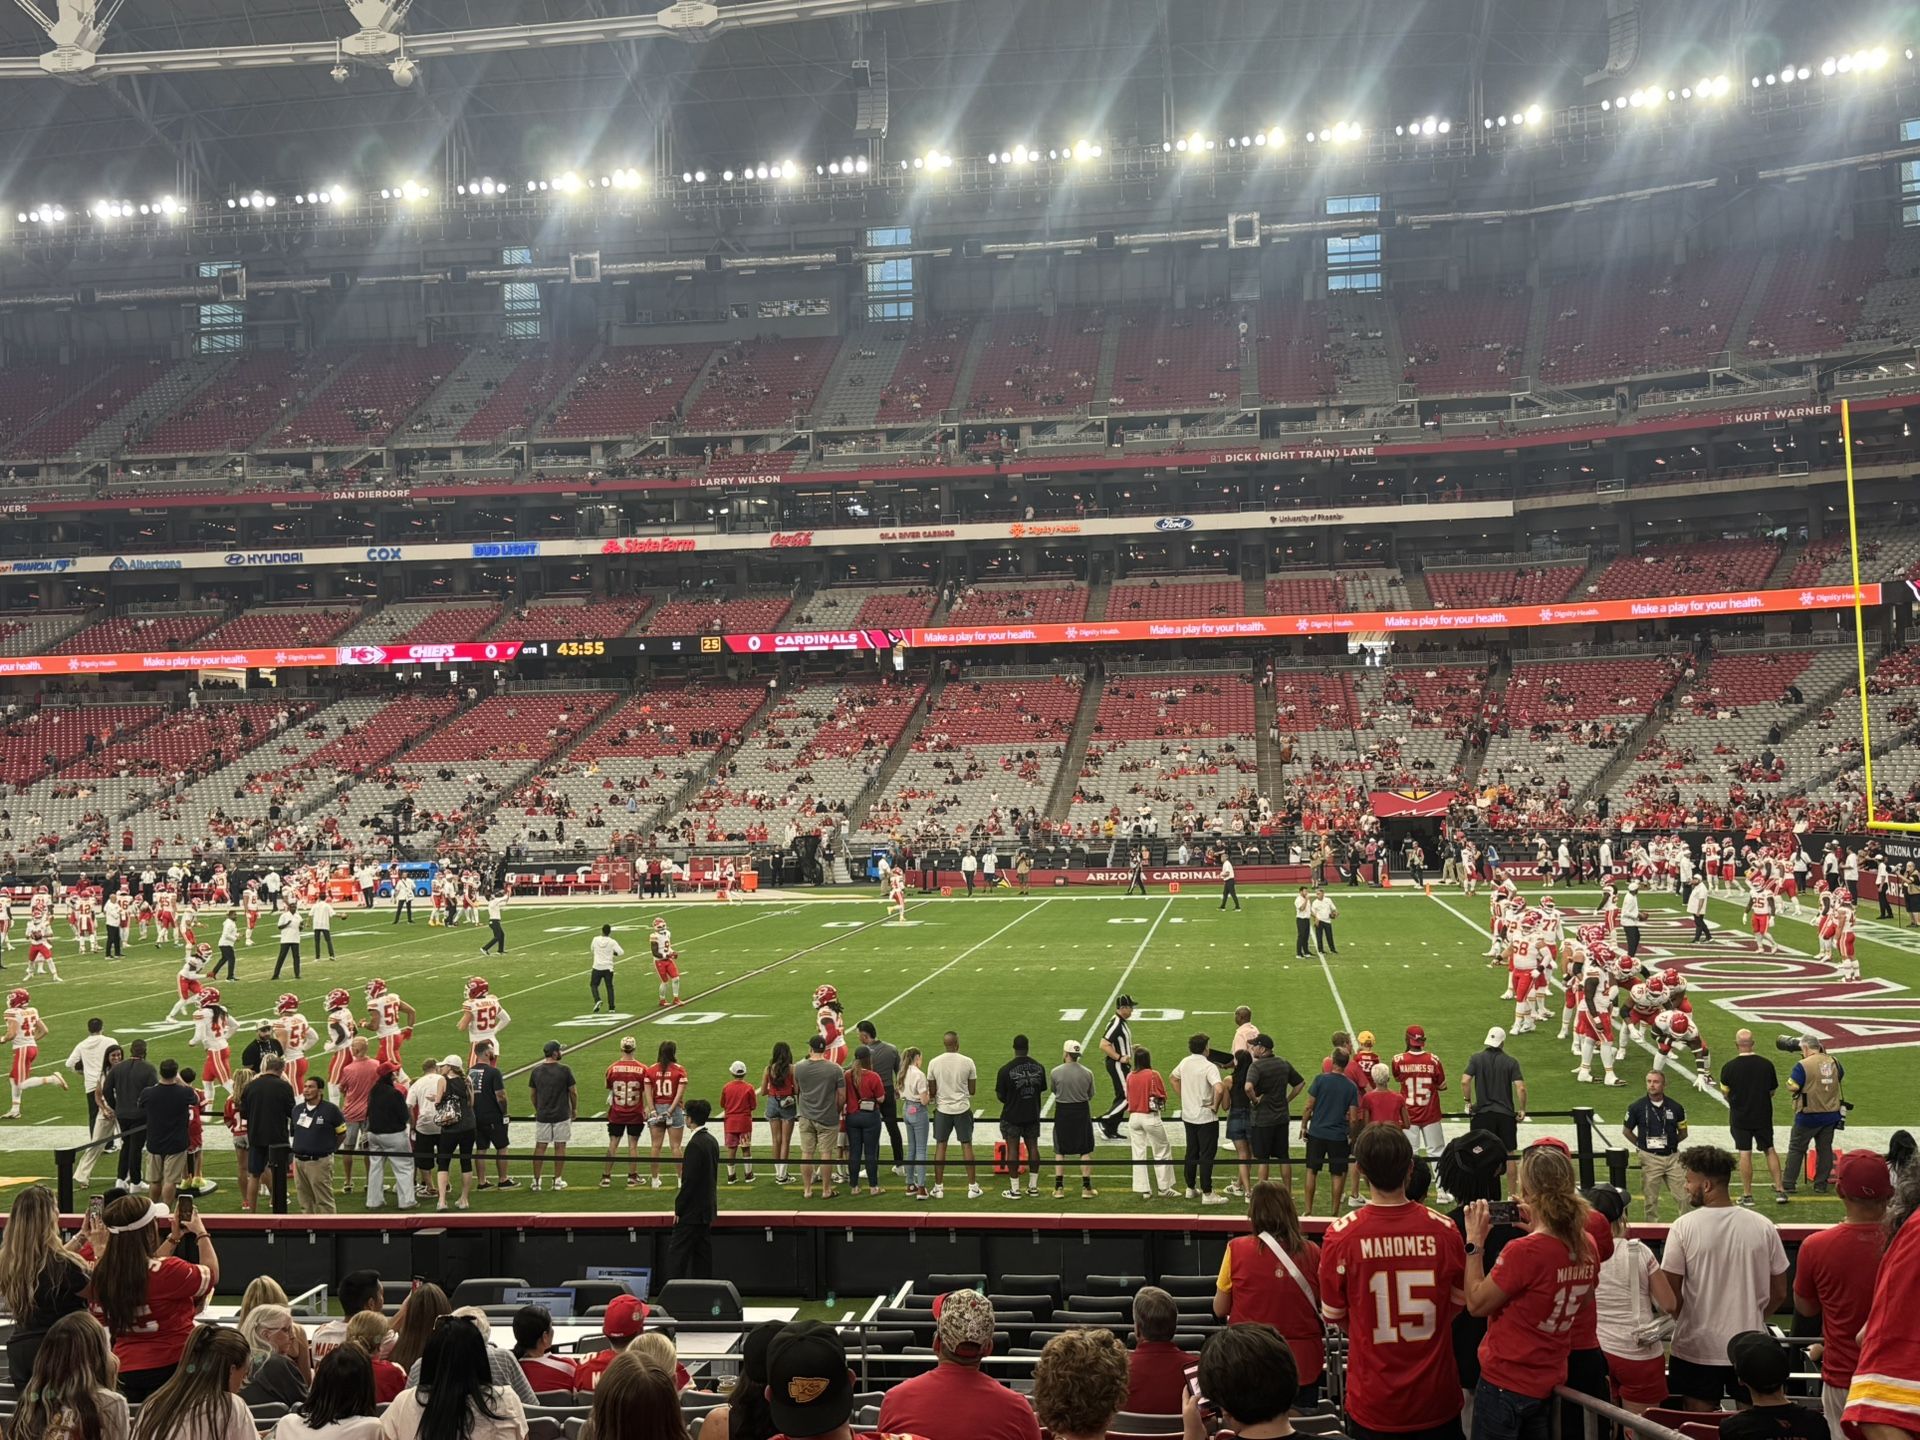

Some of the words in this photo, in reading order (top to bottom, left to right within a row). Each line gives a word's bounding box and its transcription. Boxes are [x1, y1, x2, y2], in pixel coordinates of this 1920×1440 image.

[1719, 415, 1732, 425] 13
[1735, 411, 1770, 423] KURT
[1775, 405, 1831, 418] WARNER
[1210, 455, 1222, 464] 81
[1225, 454, 1252, 462] DICK
[1255, 451, 1295, 462] (NIGHT
[1299, 449, 1340, 459] TRAIN)
[1343, 447, 1374, 457] LANE
[699, 477, 735, 486] LARRY
[738, 475, 781, 484] WILSON
[333, 491, 355, 500] DAN
[358, 489, 410, 499] DIERDORF
[1161, 518, 1185, 529] Ford
[367, 548, 402, 561] COX
[474, 544, 500, 556] BUD
[502, 543, 537, 555] LIGHT
[129, 559, 182, 570] Albertsons
[248, 552, 303, 564] HYUNDAI
[1632, 603, 1658, 614] Make
[1668, 602, 1688, 614] play
[1690, 600, 1703, 610] for
[1705, 601, 1727, 612] your
[1729, 598, 1764, 608] health.
[1385, 616, 1410, 626] Make
[1419, 614, 1438, 626] play
[1440, 614, 1452, 624] for
[1454, 616, 1474, 626] your
[1476, 614, 1508, 624] health.
[1150, 625, 1174, 635] Make
[1182, 624, 1200, 635] play
[1202, 624, 1213, 633] for
[1215, 625, 1234, 635] your
[1236, 622, 1266, 632] health.
[748, 636, 761, 650] 0
[775, 634, 858, 645] CARDINALS
[924, 632, 947, 642] Make
[956, 632, 973, 643] play
[975, 631, 986, 640] for
[987, 632, 1006, 642] your
[1007, 630, 1036, 640] health.
[409, 645, 456, 658] CHIEFS
[485, 644, 497, 658] 0
[522, 646, 537, 654] QTR
[540, 644, 548, 656] 1
[557, 642, 605, 656] 43:55
[704, 640, 719, 649] 25
[0, 664, 15, 672] your
[16, 661, 43, 670] health.
[143, 658, 165, 666] Make
[172, 656, 189, 667] play
[190, 656, 202, 665] for
[202, 657, 220, 667] your
[220, 655, 248, 664] health.
[1885, 845, 1911, 858] ARIZONA
[1543, 919, 1558, 931] 77
[477, 1007, 498, 1031] 59
[552, 1012, 729, 1026] 20
[612, 1080, 640, 1106] 96
[656, 1080, 672, 1096] 10
[1405, 1077, 1433, 1106] 15
[1360, 1236, 1436, 1260] MAHOMES
[1556, 1264, 1595, 1284] MAHOMES
[1369, 1270, 1437, 1344] 15
[1537, 1284, 1591, 1334] 15
